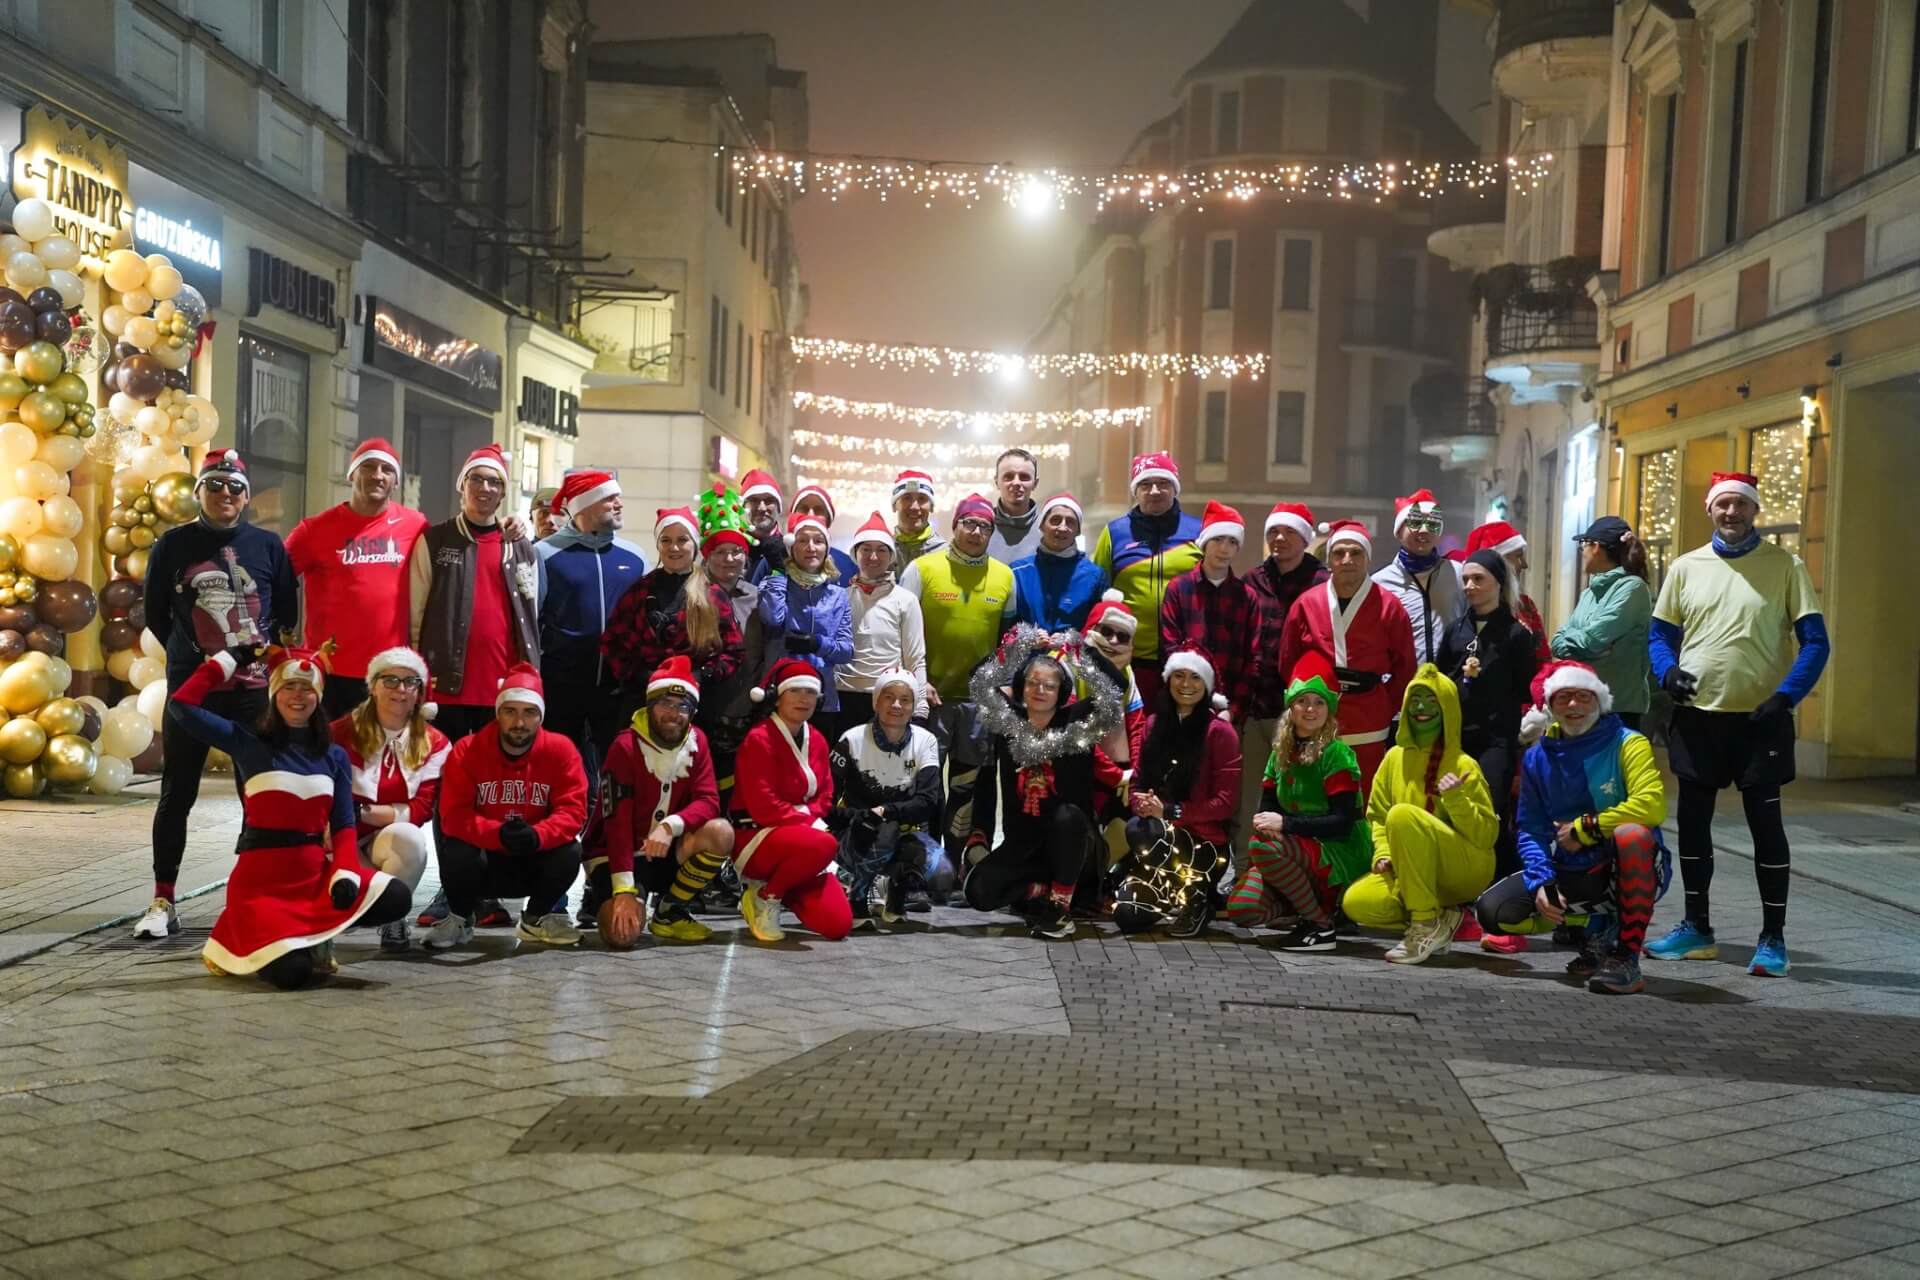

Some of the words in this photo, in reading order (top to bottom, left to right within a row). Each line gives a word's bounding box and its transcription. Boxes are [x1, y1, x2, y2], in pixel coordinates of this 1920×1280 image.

[44, 157, 123, 230] TANDYR
[136, 207, 221, 271] GRUZIŃSKA
[247, 247, 336, 329] JUBILER
